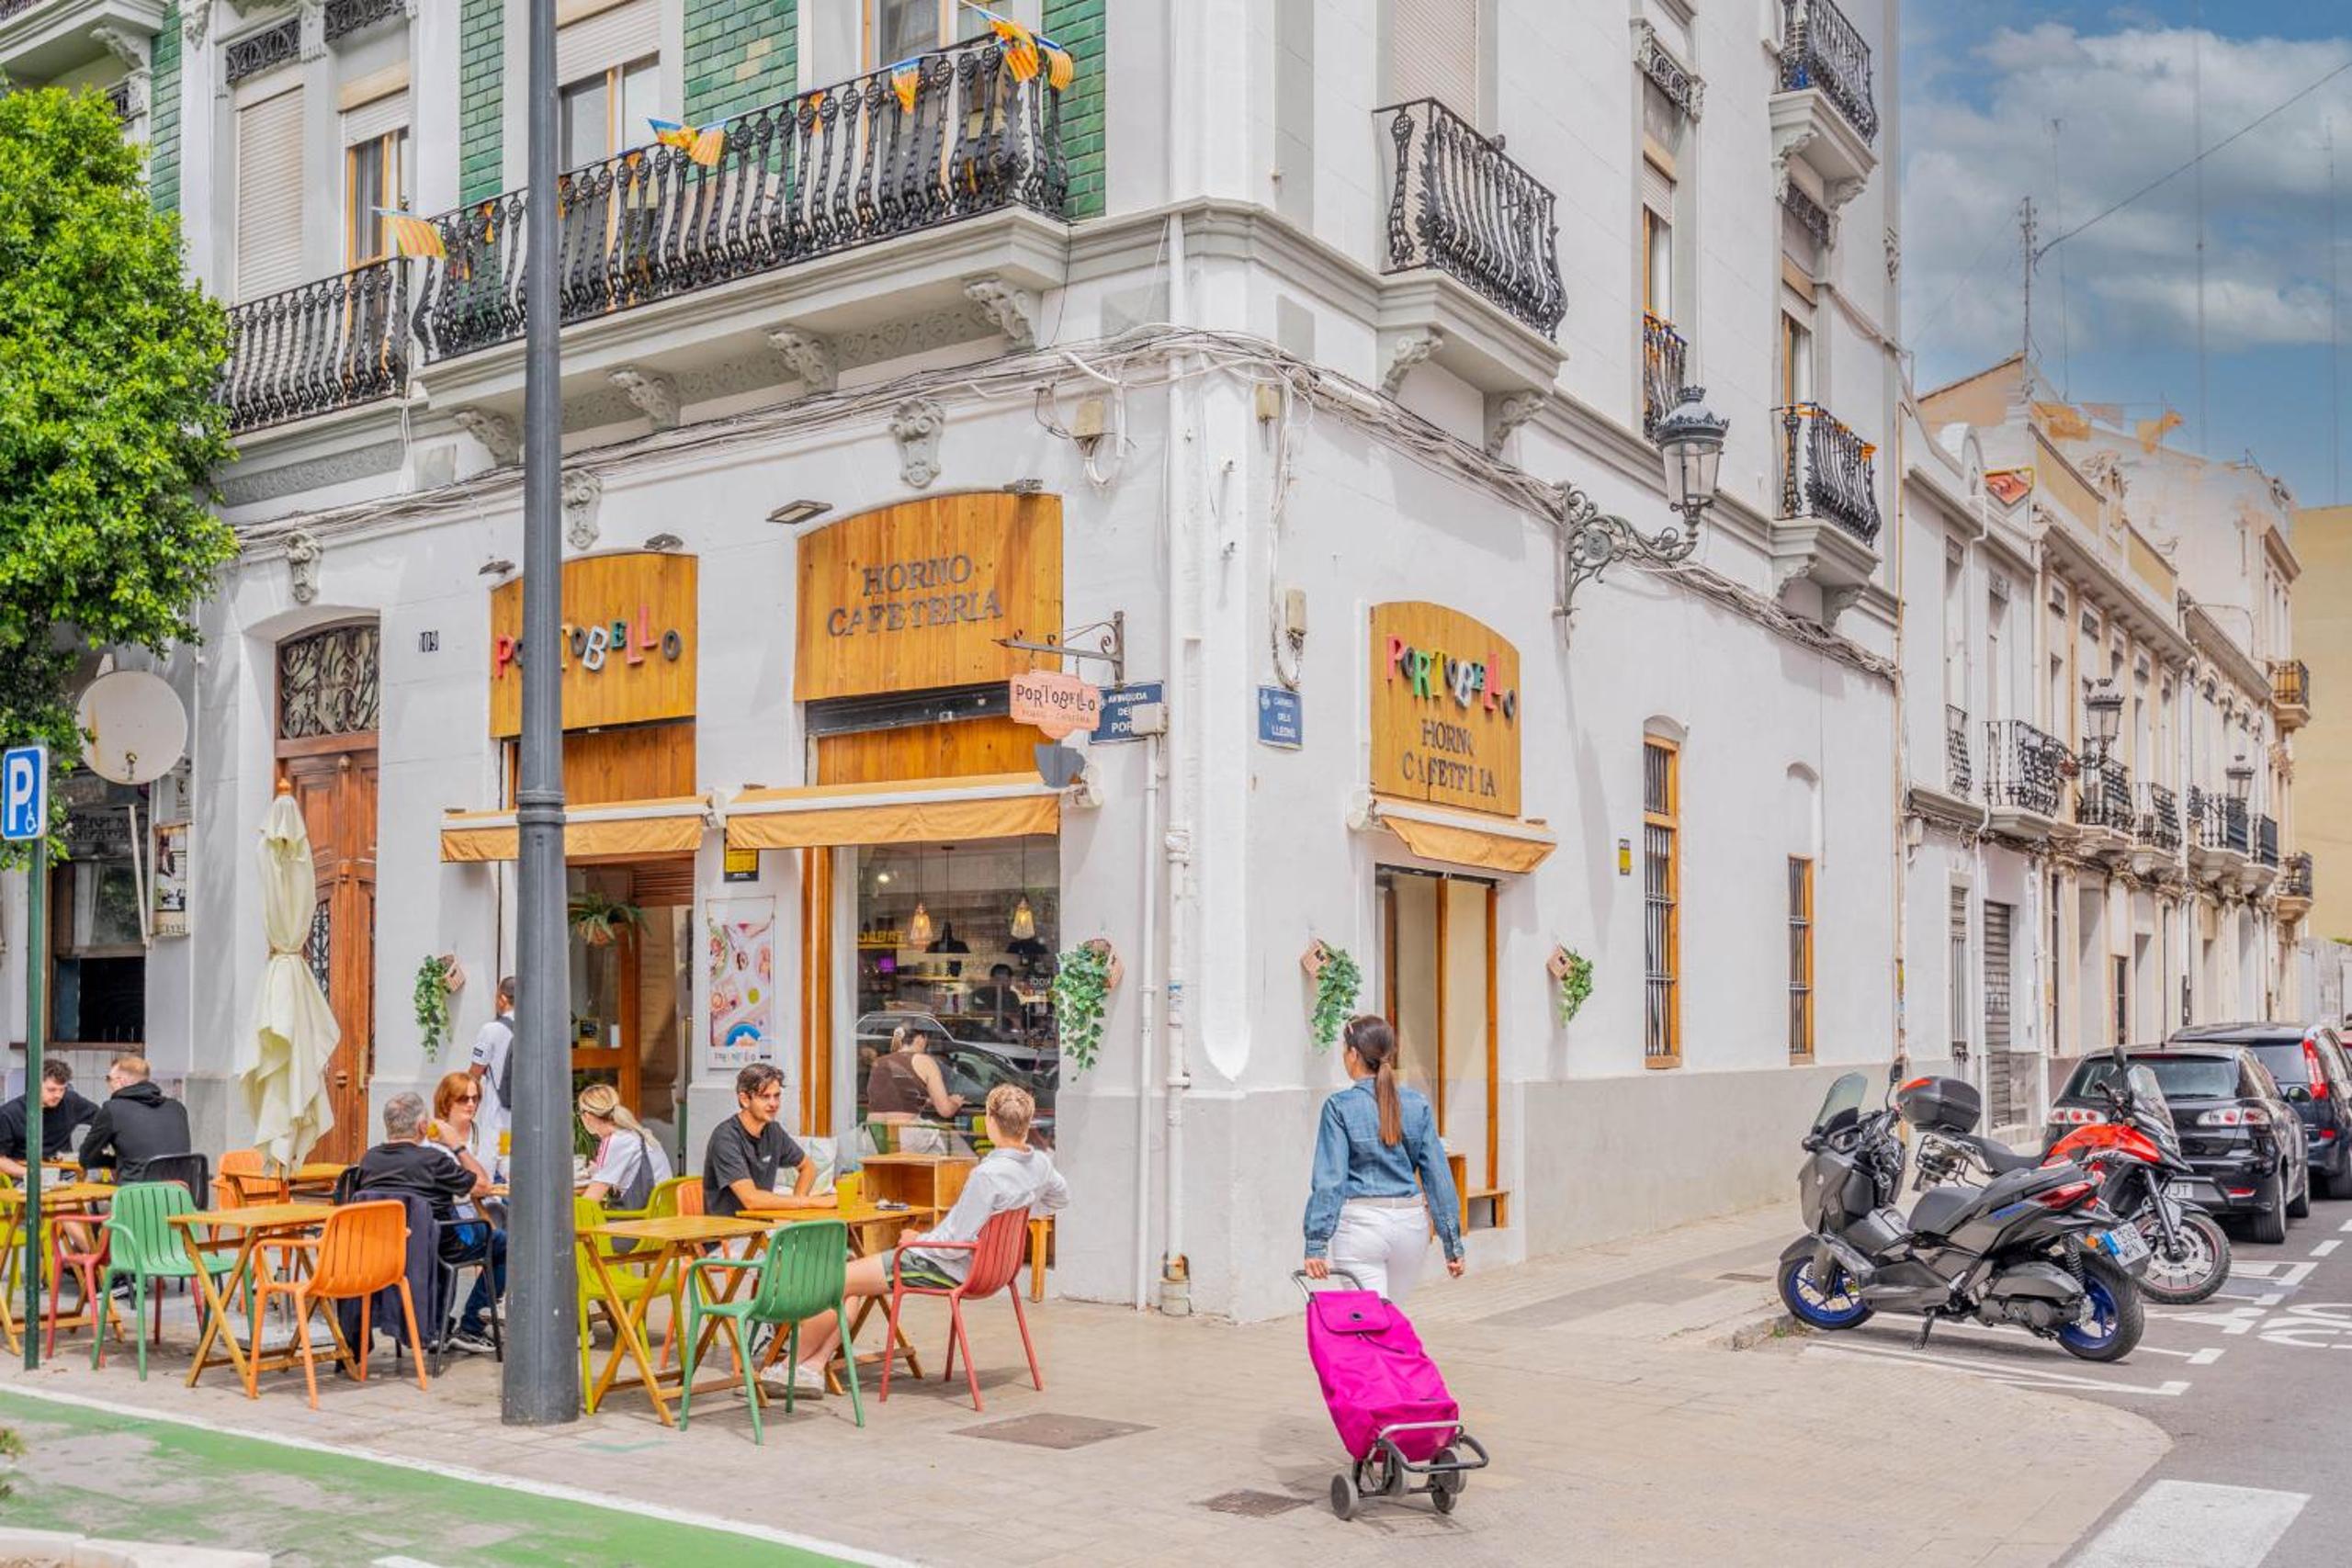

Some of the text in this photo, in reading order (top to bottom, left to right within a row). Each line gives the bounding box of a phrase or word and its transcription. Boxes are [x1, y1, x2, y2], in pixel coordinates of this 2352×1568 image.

[863, 555, 972, 596] HORNO
[496, 604, 681, 678] POTOBELLO
[828, 590, 1002, 637] CAFETERIA
[1016, 684, 1095, 711] PORTOBELLO
[1386, 634, 1516, 718] PORTOBELLO
[9, 758, 34, 830] P
